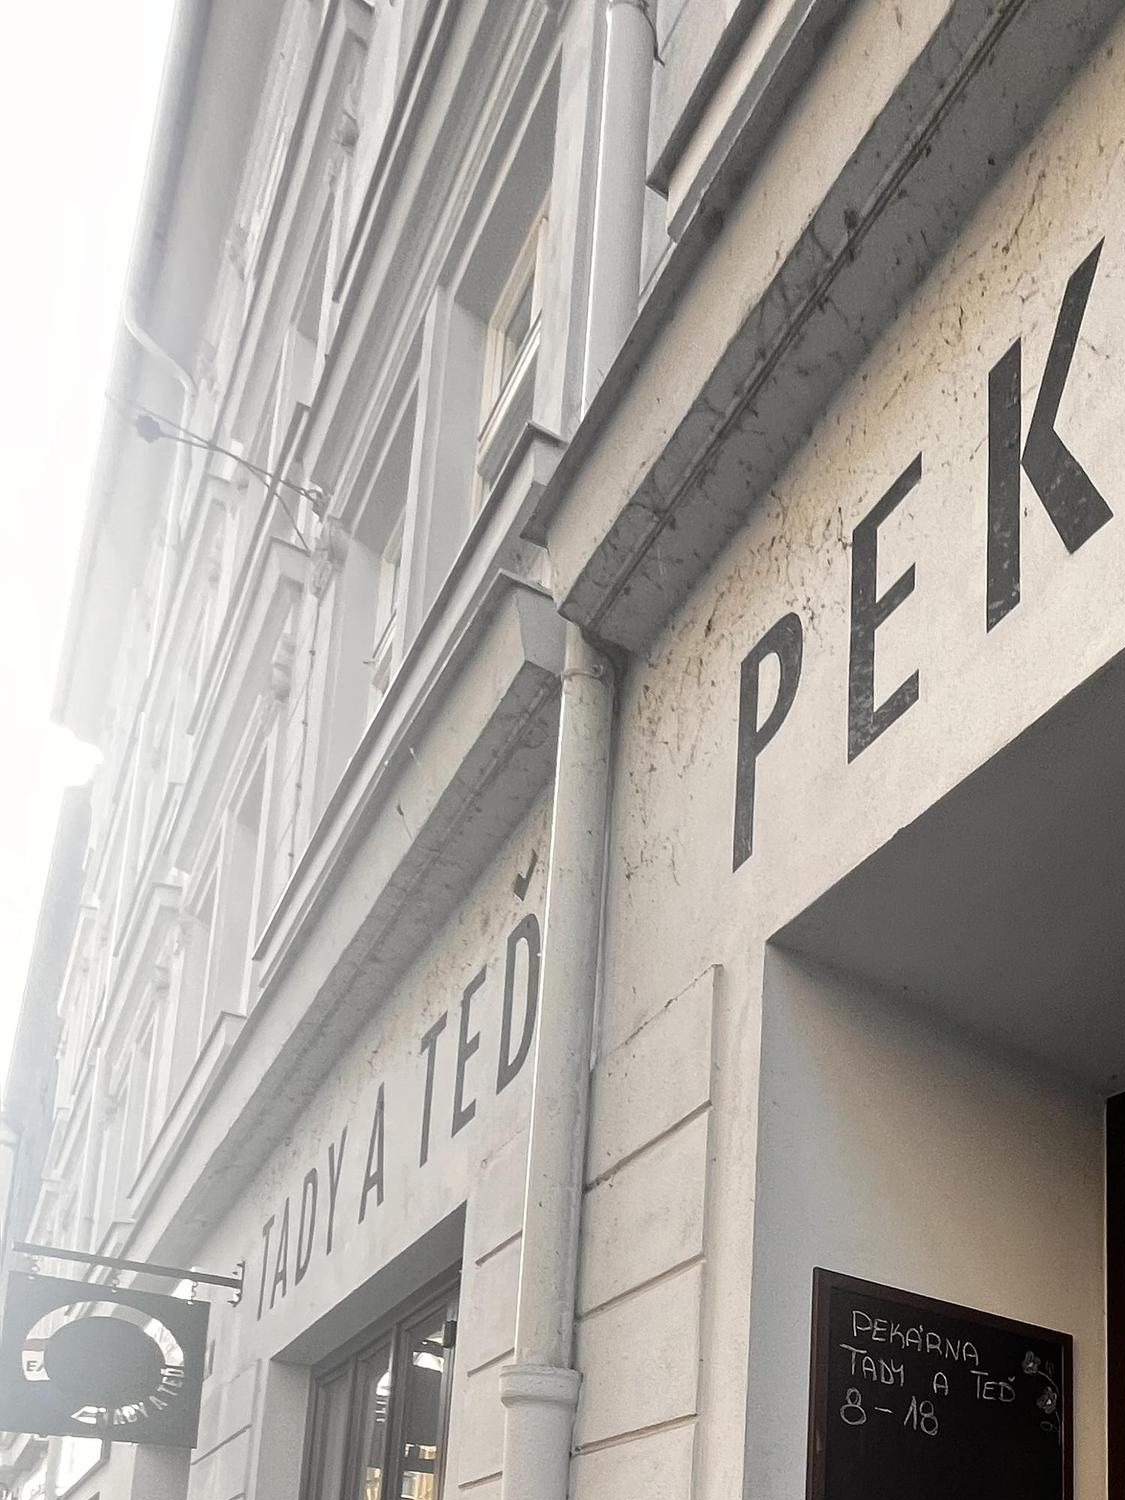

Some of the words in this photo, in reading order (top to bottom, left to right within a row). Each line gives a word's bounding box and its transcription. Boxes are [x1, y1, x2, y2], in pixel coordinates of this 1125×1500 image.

[257, 1125, 347, 1321] TADY
[358, 1081, 385, 1224] A
[419, 849, 541, 1168] TEĎ
[852, 1310, 979, 1366] PEKÁRNA
[840, 1343, 904, 1387] TADY
[933, 1371, 949, 1396] A
[970, 1369, 1016, 1402] TEĎ
